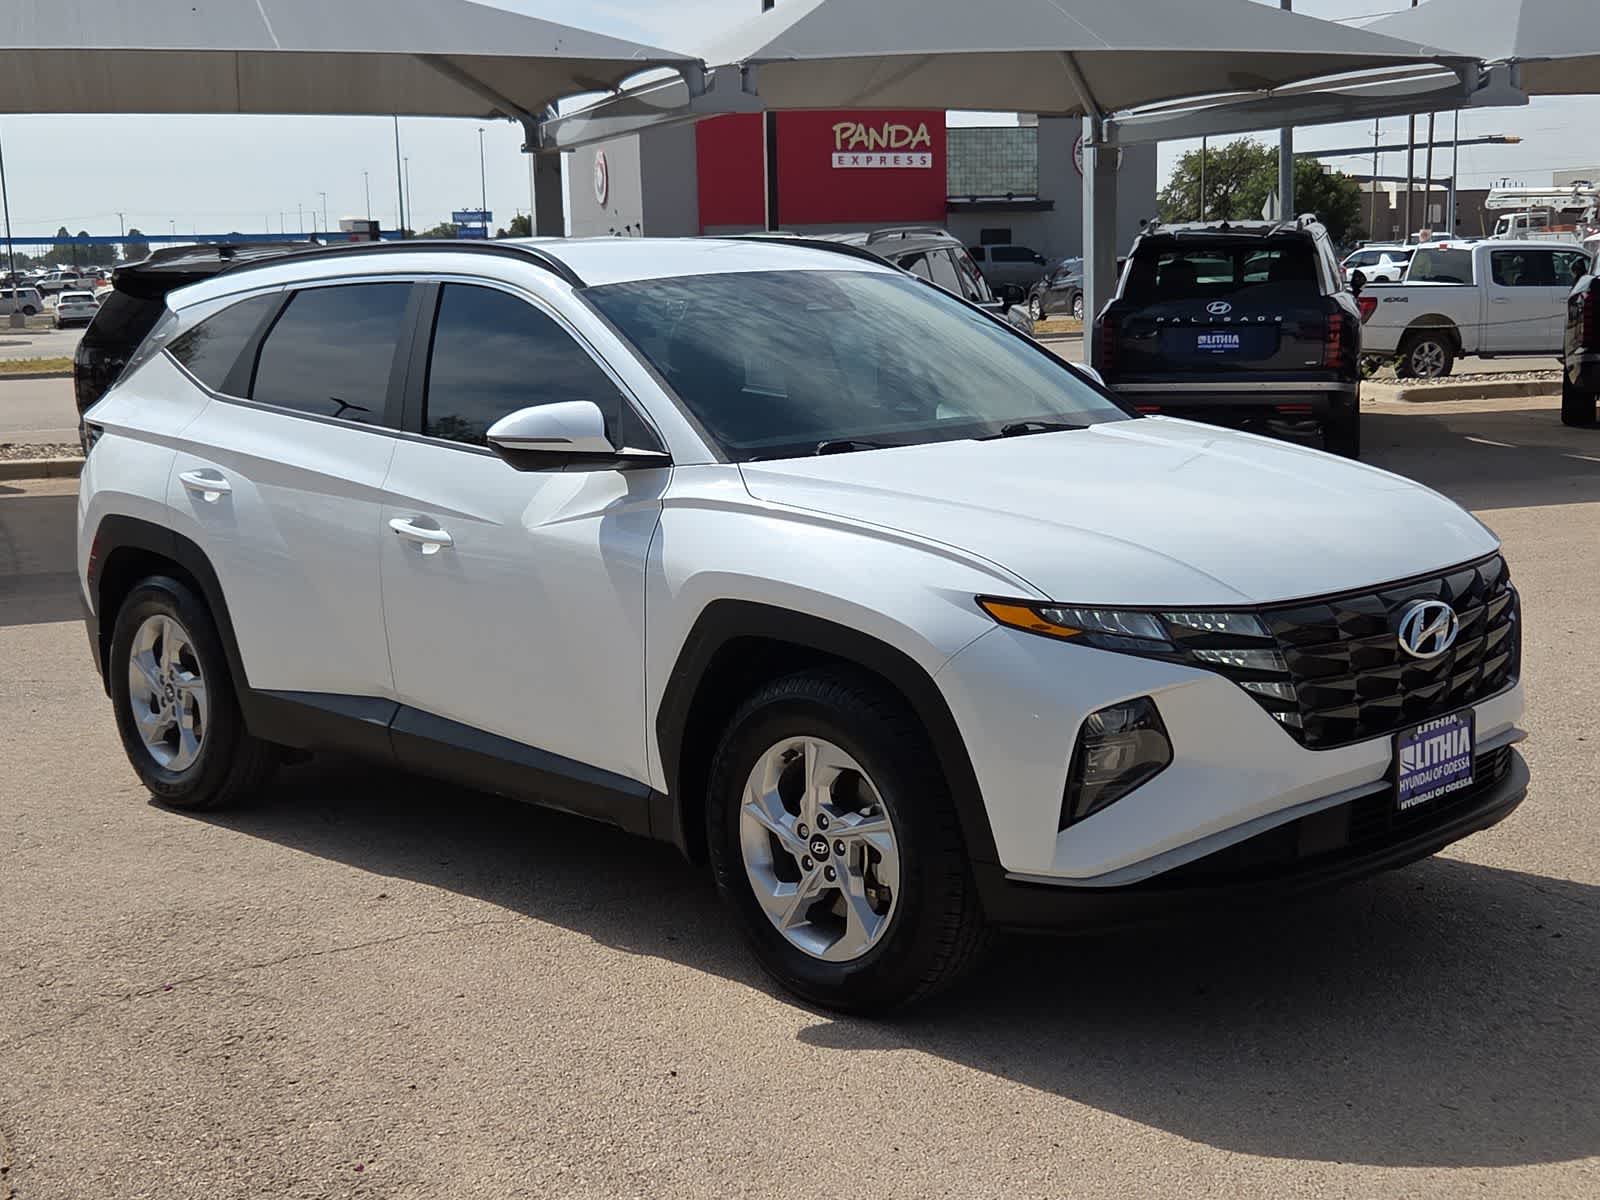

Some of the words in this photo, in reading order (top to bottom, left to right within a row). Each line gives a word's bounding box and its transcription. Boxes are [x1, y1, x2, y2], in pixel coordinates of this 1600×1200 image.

[832, 121, 931, 150] PANDA
[837, 155, 927, 166] EXPRESS
[1207, 334, 1240, 344] LITHIA
[1417, 713, 1457, 734] LITHIA
[1416, 726, 1471, 770] LITHIA
[1400, 769, 1433, 792] HYUNDAI
[1433, 766, 1443, 780] OF
[1443, 756, 1470, 776] ODESSA
[1401, 790, 1434, 810] HYUNDAI
[1435, 786, 1444, 796] OF
[1445, 777, 1473, 793] ODESSA
